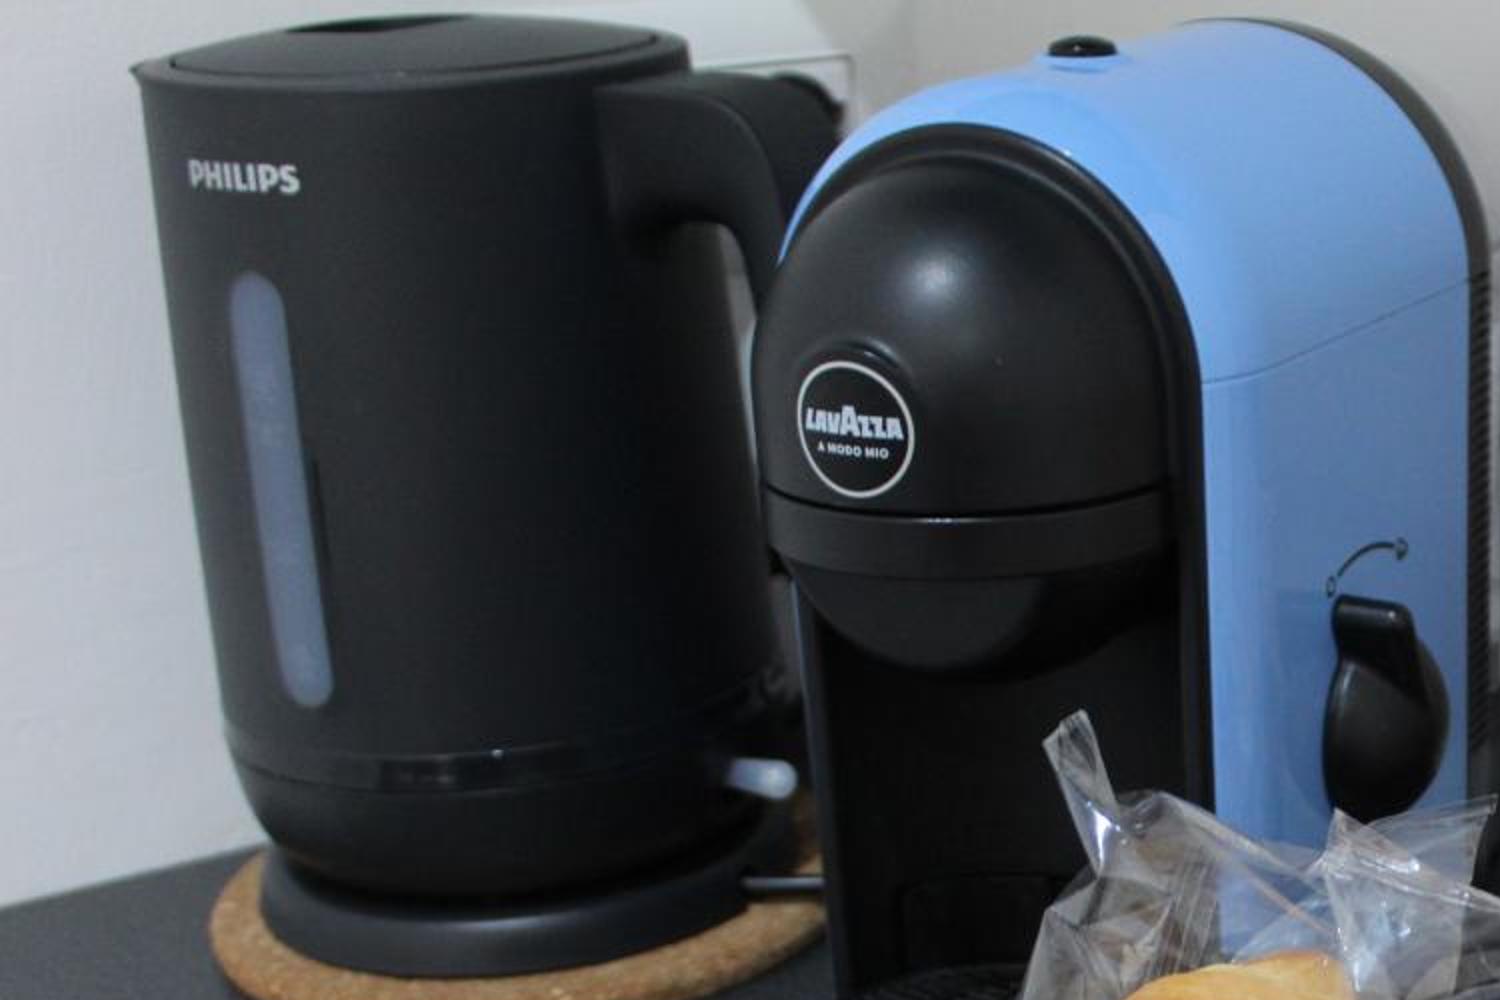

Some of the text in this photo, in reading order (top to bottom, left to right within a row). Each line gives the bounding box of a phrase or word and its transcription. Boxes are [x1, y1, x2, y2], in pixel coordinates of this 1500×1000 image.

[187, 158, 301, 195] PHILIPS
[805, 405, 904, 440] LAVAZZA
[817, 441, 890, 460] A MODO MIO
